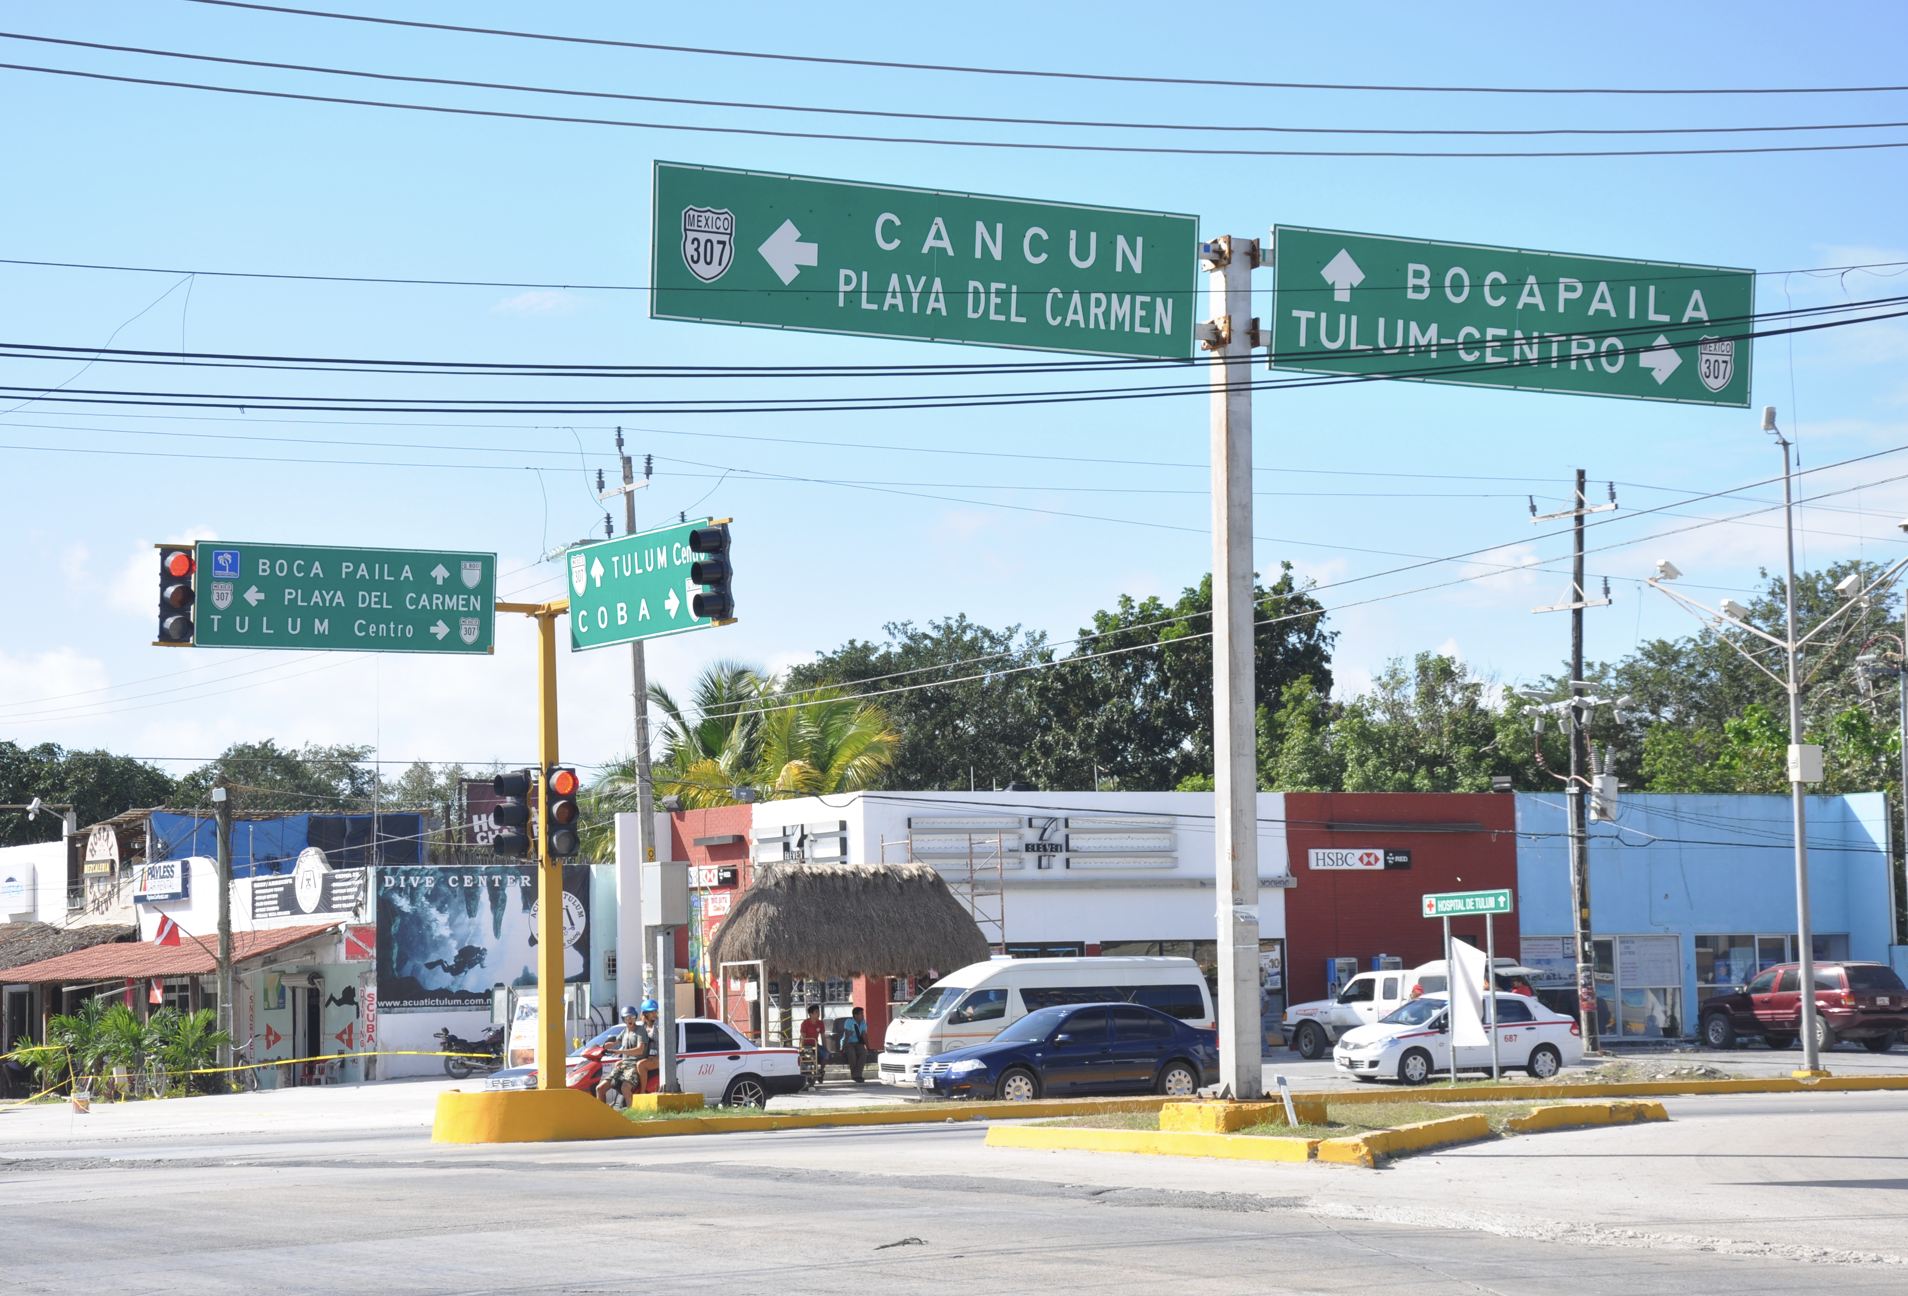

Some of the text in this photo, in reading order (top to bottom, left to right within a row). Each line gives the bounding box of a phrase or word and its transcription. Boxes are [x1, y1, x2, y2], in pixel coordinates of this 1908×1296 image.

[687, 214, 730, 232] MEXICO
[690, 237, 727, 266] 307
[874, 212, 1144, 274] CANCUN
[838, 268, 1173, 336] PLAYA DEL CARMEN
[1407, 262, 1711, 325] BOCAPAILA
[1291, 310, 1626, 374] TULUM-CENTRO
[1702, 342, 1731, 355] MEXICO
[1704, 358, 1729, 380] 307
[258, 559, 414, 582] BOCA PAILA
[611, 545, 668, 579] TULUM
[215, 591, 229, 601] 307
[284, 589, 481, 612] PLAYA DEL CARMEN
[210, 615, 414, 638] TULUM Centro
[578, 598, 651, 633] COBA
[463, 626, 476, 636] 307
[88, 826, 115, 859] HOSTAL
[1314, 851, 1356, 867] HSBC
[147, 864, 175, 880] PAYLESS
[384, 875, 532, 888] DIVE CENTER
[562, 892, 585, 919] TULUM
[1437, 899, 1465, 912] HOSPITAL
[1465, 898, 1475, 910] DE
[366, 992, 376, 1044] SCUBA
[1503, 1034, 1518, 1043] 687
[696, 1063, 716, 1076] 130
